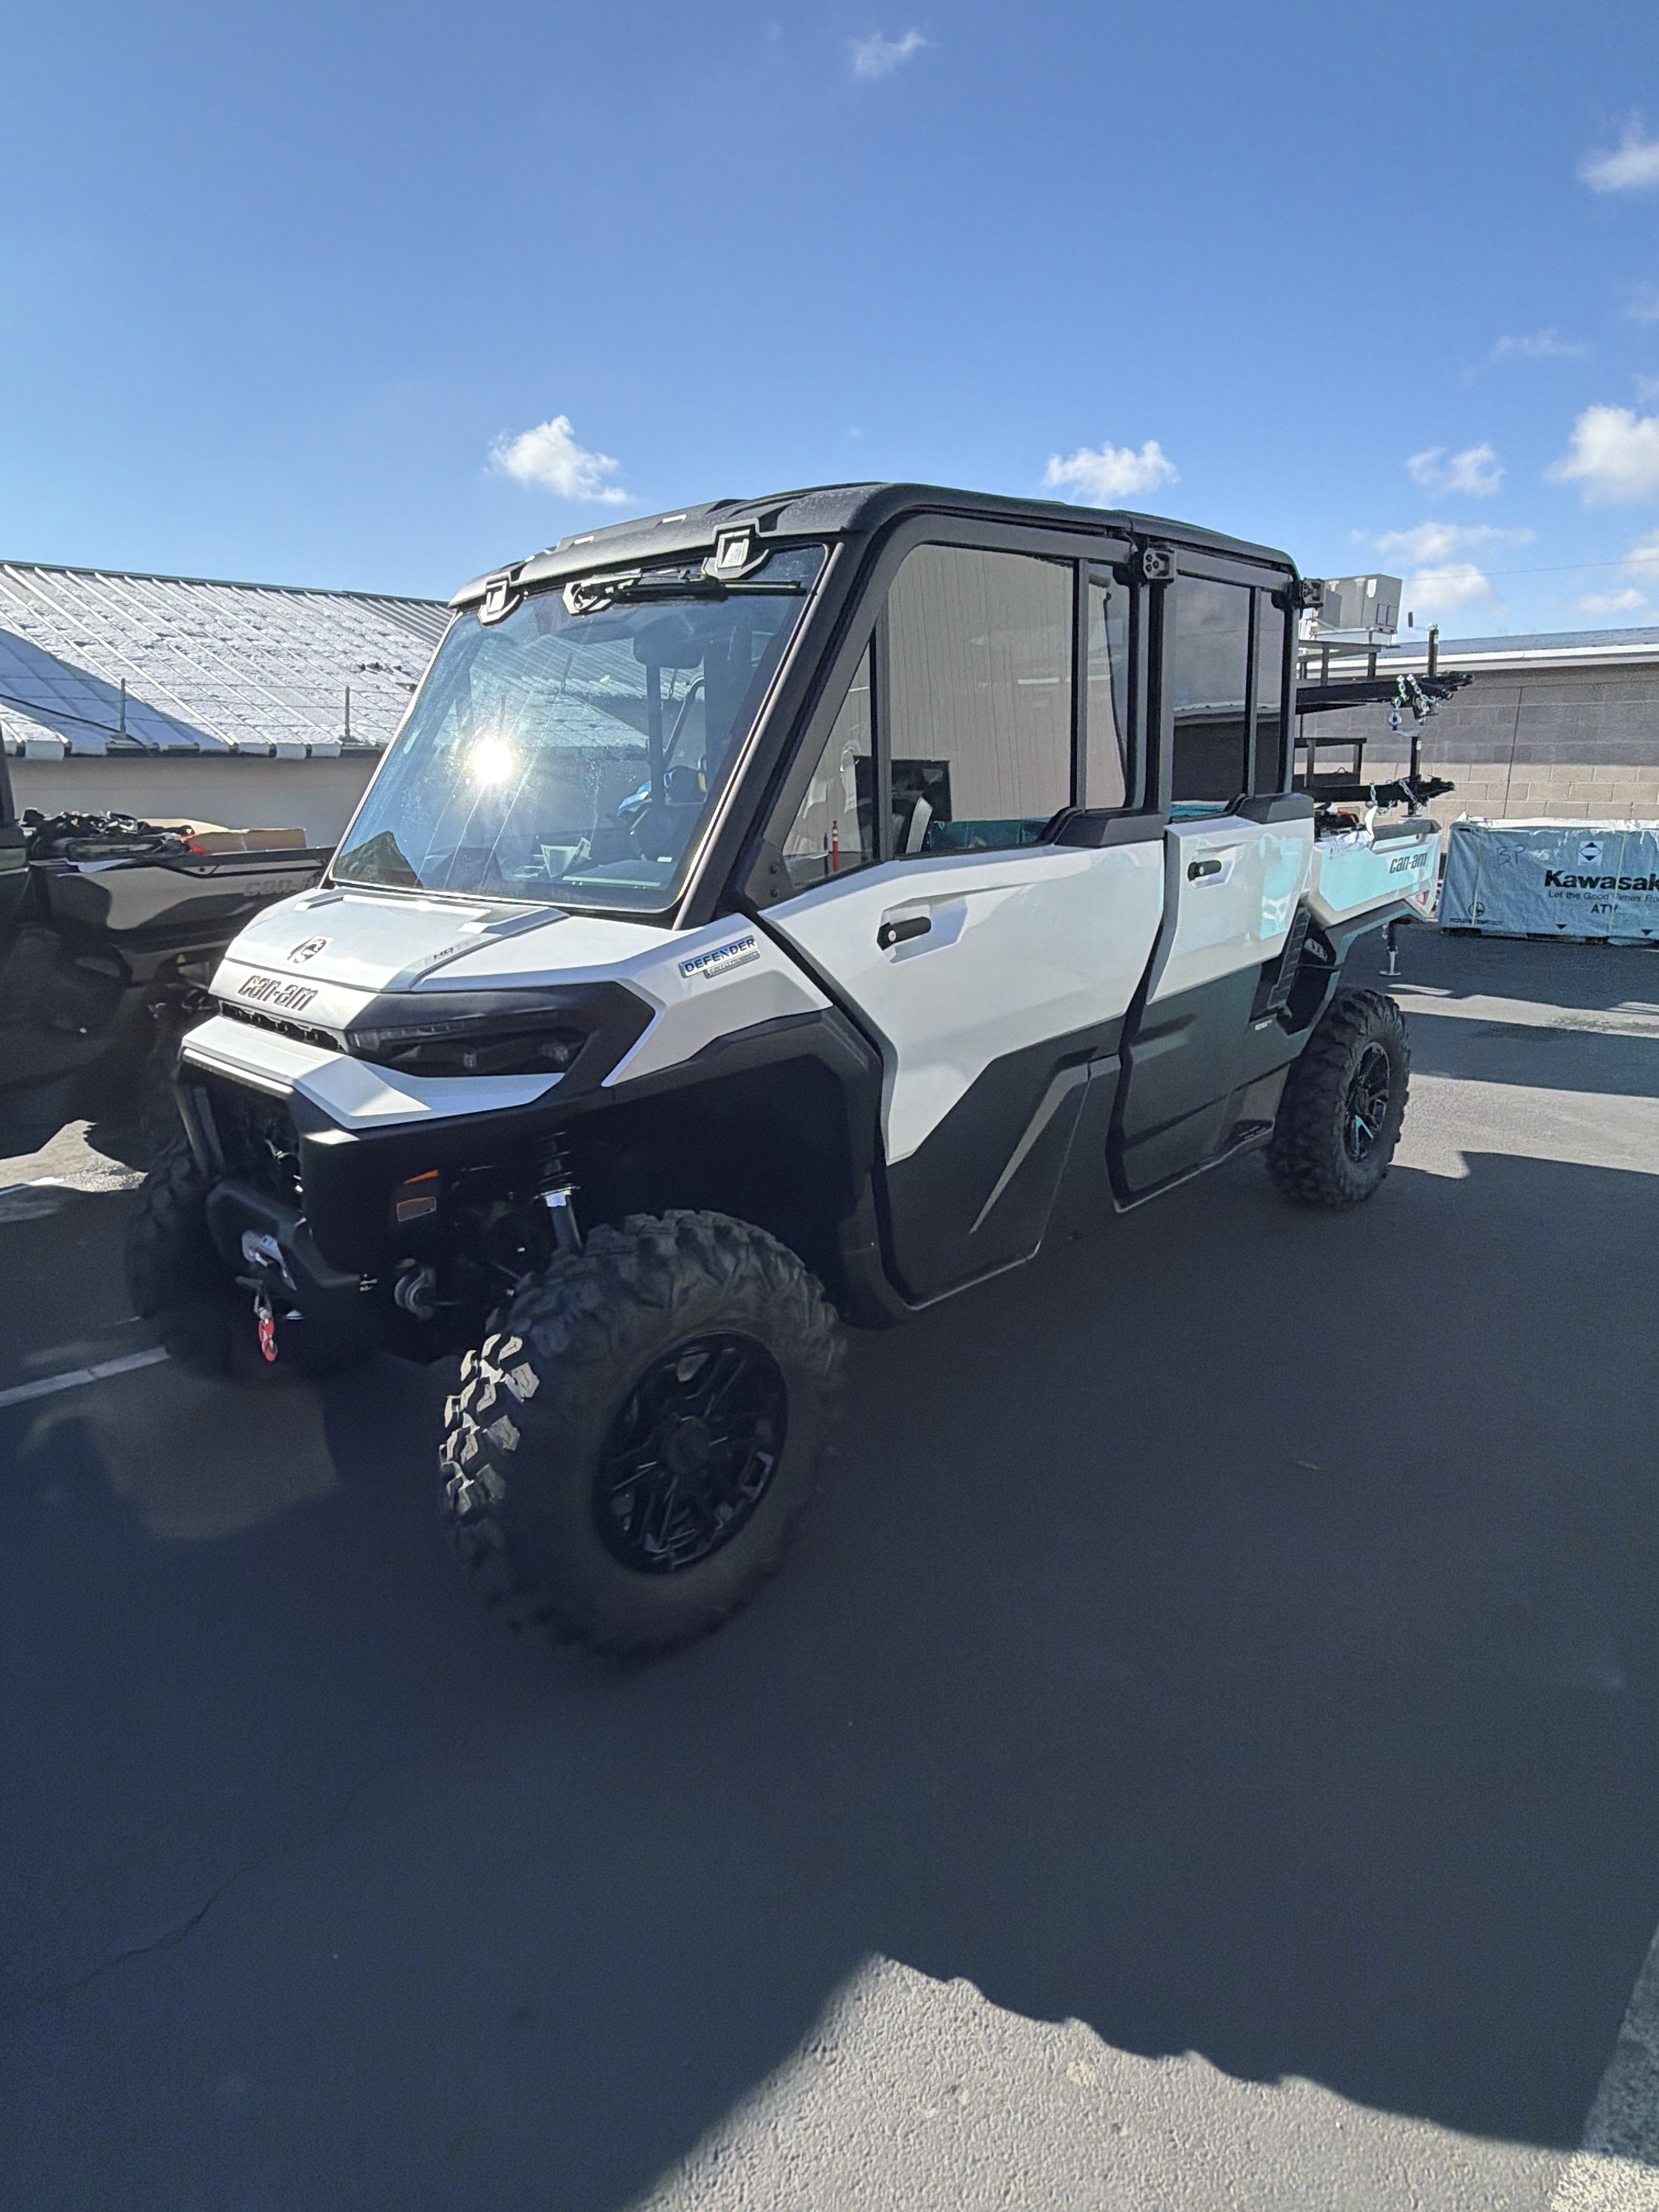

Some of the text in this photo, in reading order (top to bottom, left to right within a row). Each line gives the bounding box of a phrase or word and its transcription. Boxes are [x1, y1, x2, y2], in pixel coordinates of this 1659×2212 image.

[1389, 852, 1428, 873] can-am
[1548, 890, 1563, 899] Let
[685, 938, 755, 972] DEFENDER
[238, 975, 318, 1011] can-am
